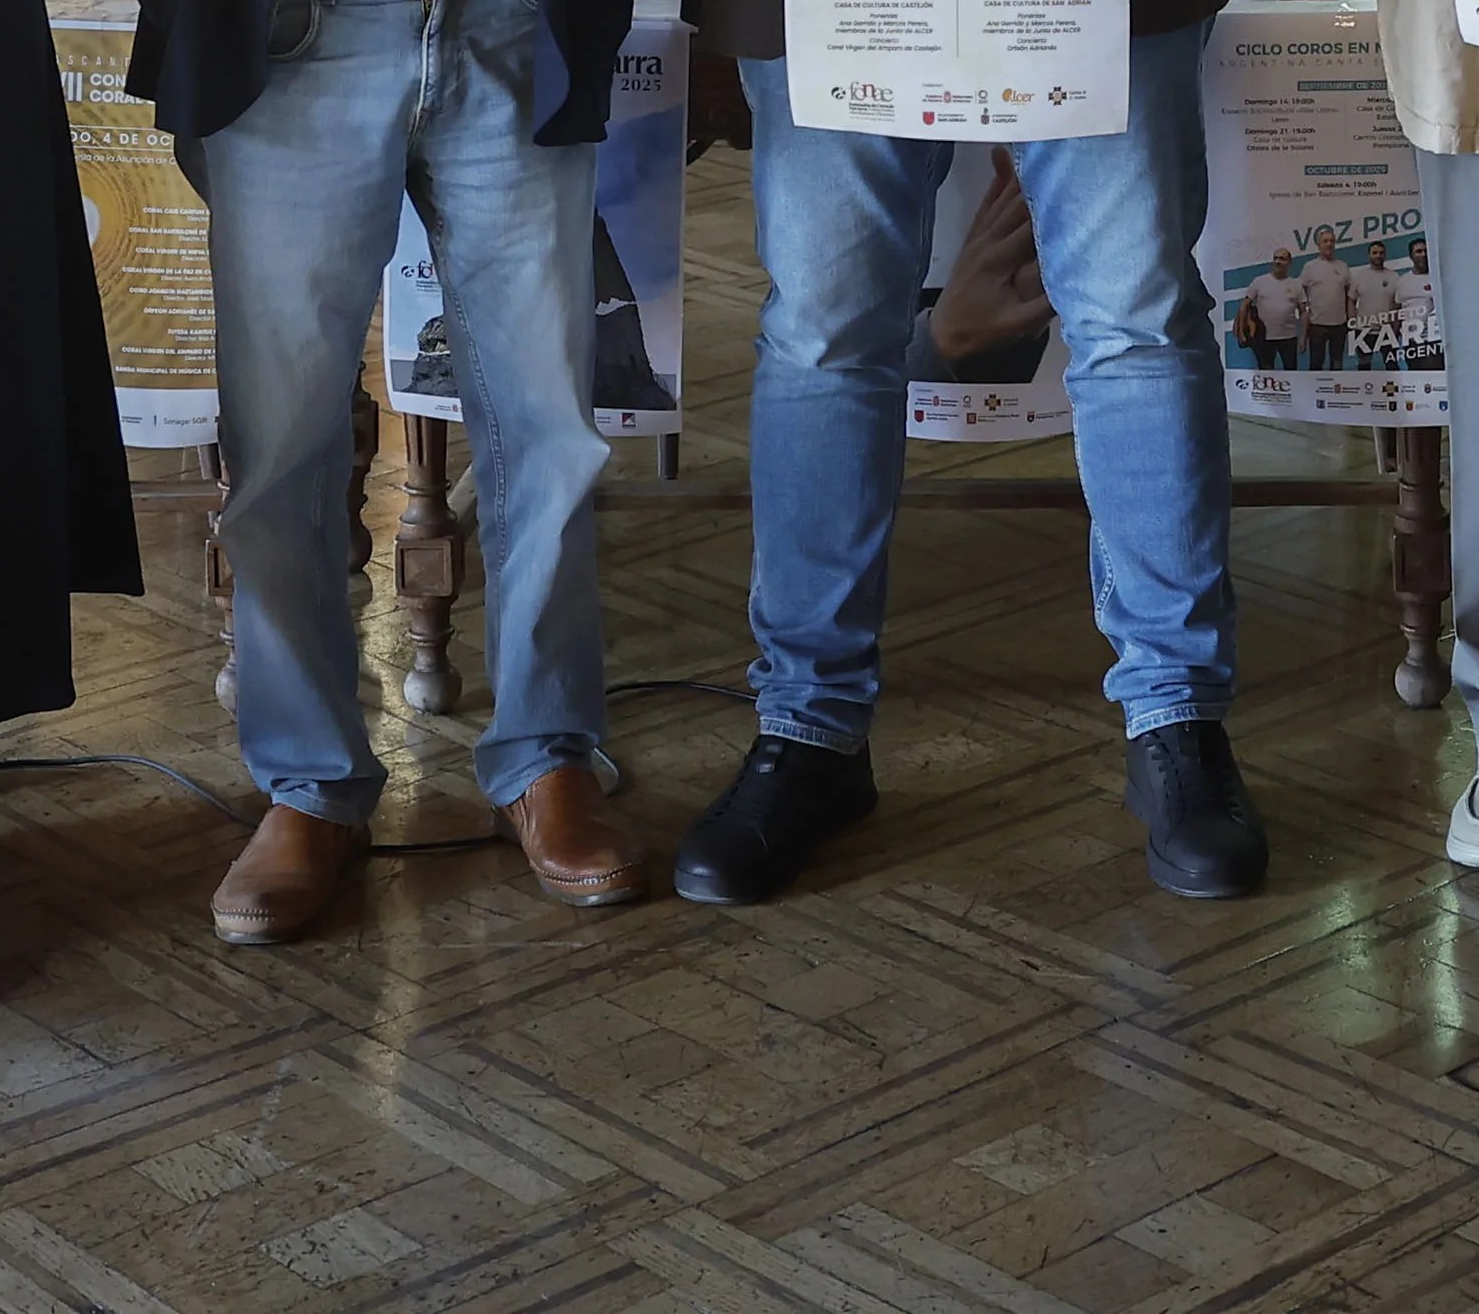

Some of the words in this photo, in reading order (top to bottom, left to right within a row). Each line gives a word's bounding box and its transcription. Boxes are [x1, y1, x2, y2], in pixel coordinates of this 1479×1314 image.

[1236, 44, 1282, 56] CICLO
[1288, 43, 1343, 54] COROS
[1349, 42, 1369, 53] EN
[621, 79, 660, 91] 2025
[1348, 307, 1426, 329] CUARTETO
